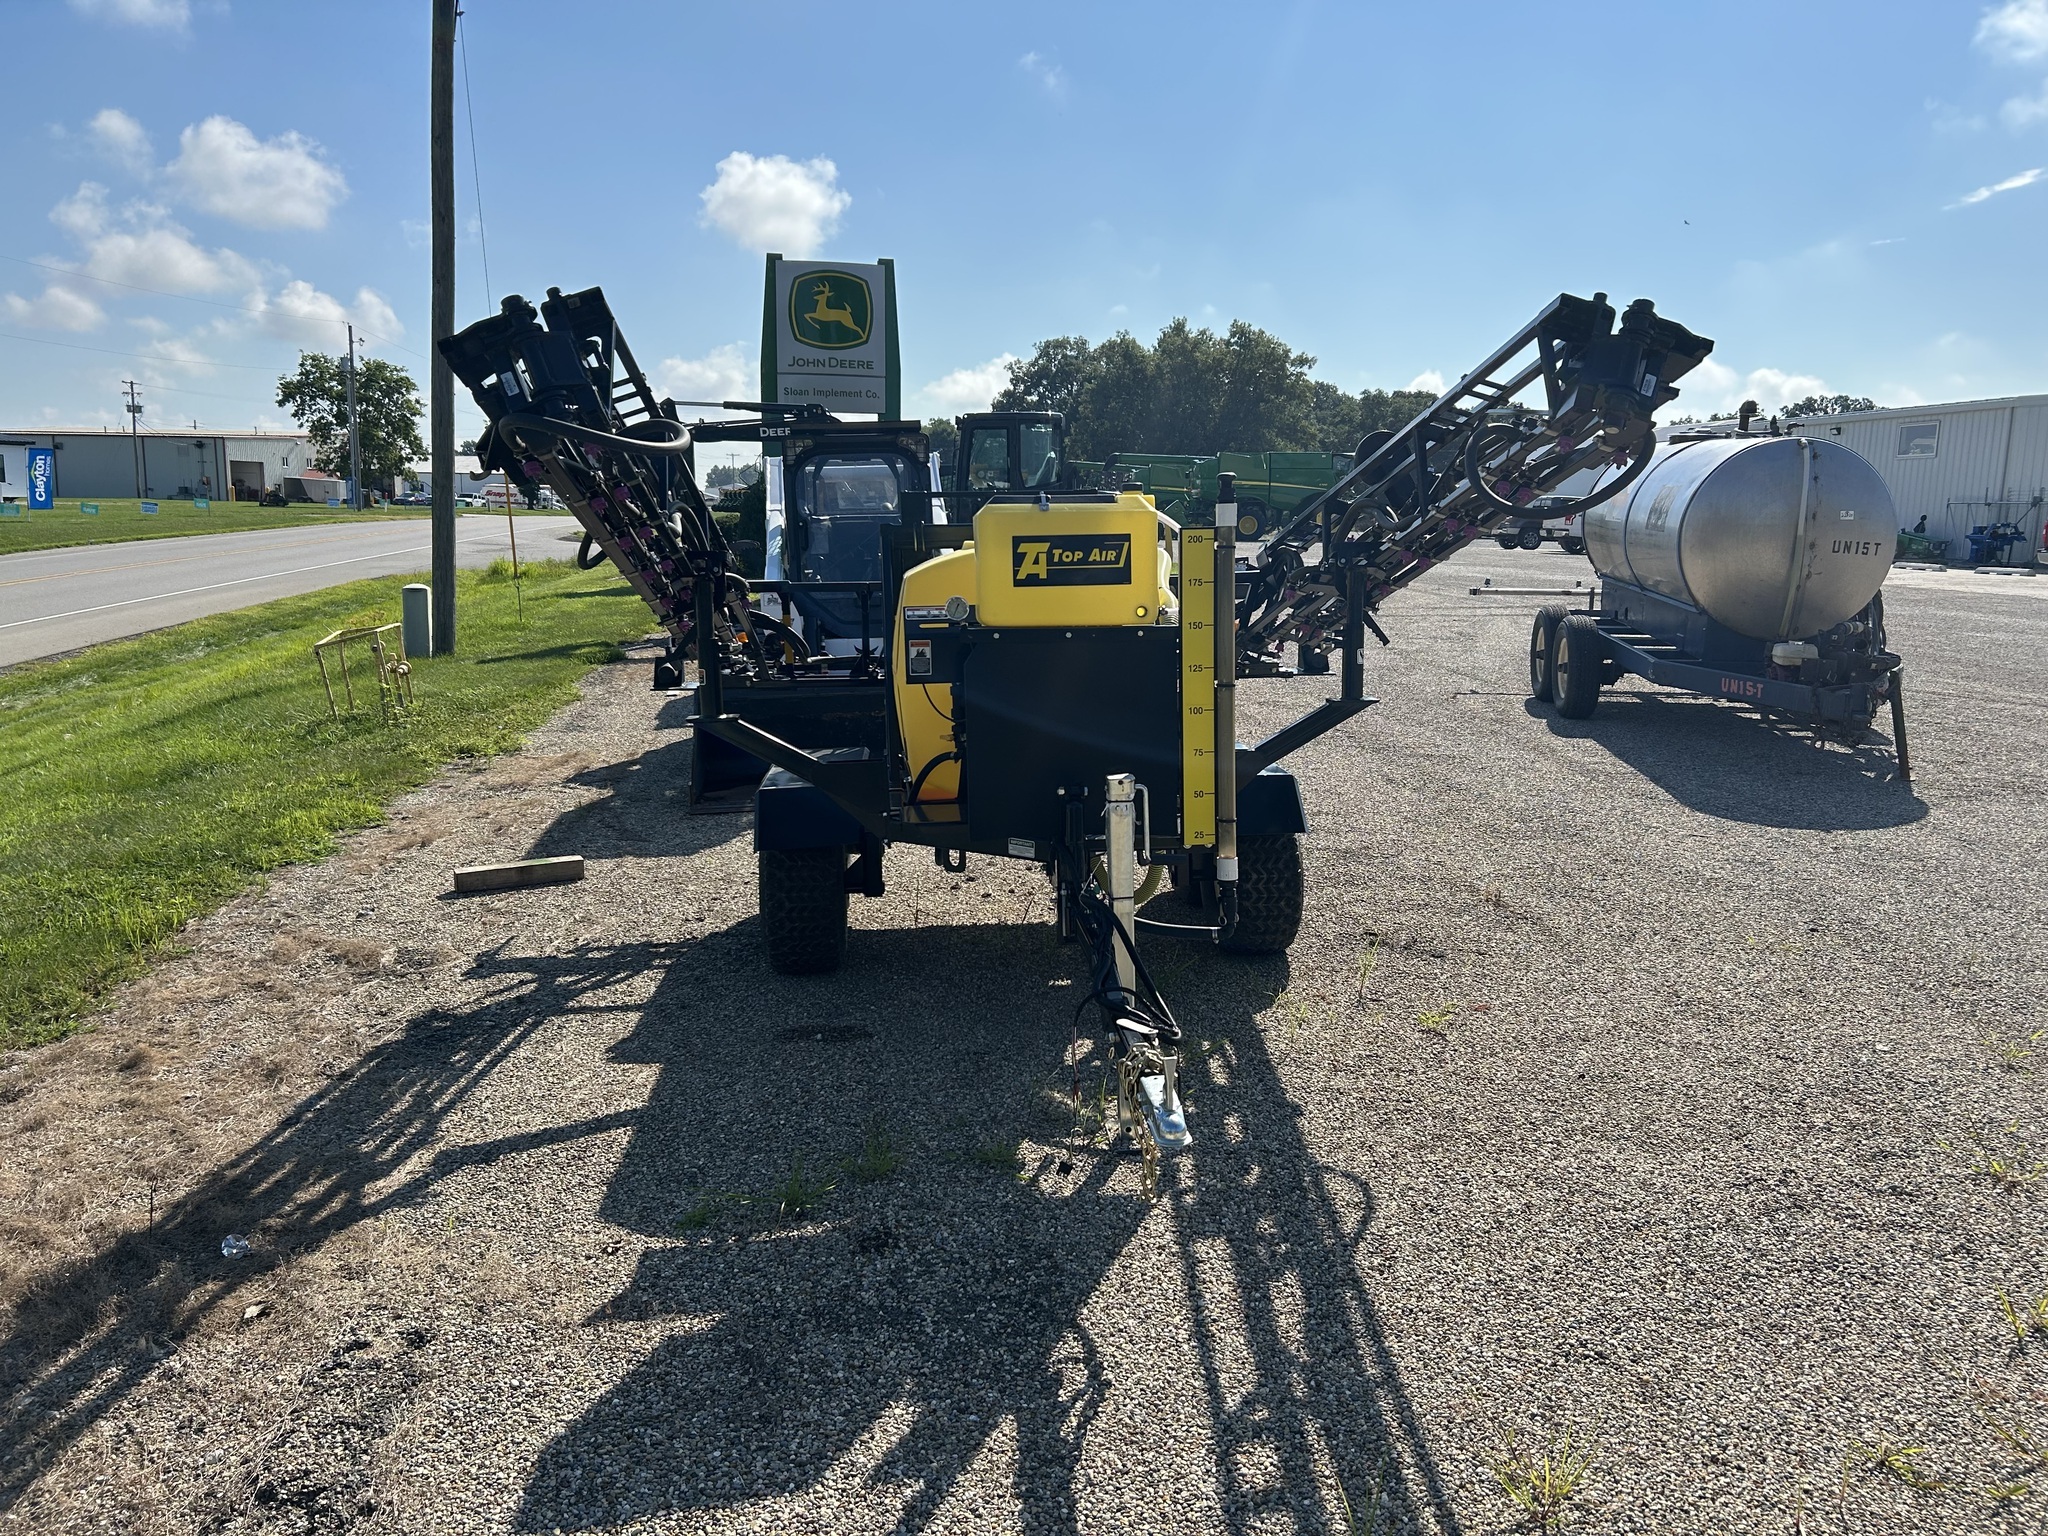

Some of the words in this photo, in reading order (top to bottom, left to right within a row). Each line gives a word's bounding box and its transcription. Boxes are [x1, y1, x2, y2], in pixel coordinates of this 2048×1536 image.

[788, 356, 825, 367] JOHN
[828, 357, 874, 369] DEERE
[784, 386, 809, 396] Sloan
[813, 388, 862, 398] Implement
[866, 390, 880, 398] Co.
[760, 427, 791, 437] DEER
[34, 455, 46, 502] Clayton
[485, 490, 517, 498] Snapon
[1052, 549, 1084, 562] TOP
[1088, 548, 1117, 562] AIR
[1188, 578, 1202, 586] 175
[1188, 622, 1202, 630] 150
[1188, 664, 1202, 672] 125
[1188, 707, 1203, 715] 100
[1194, 748, 1204, 756] 75
[1194, 790, 1204, 798] 50
[1194, 831, 1204, 839] 25
